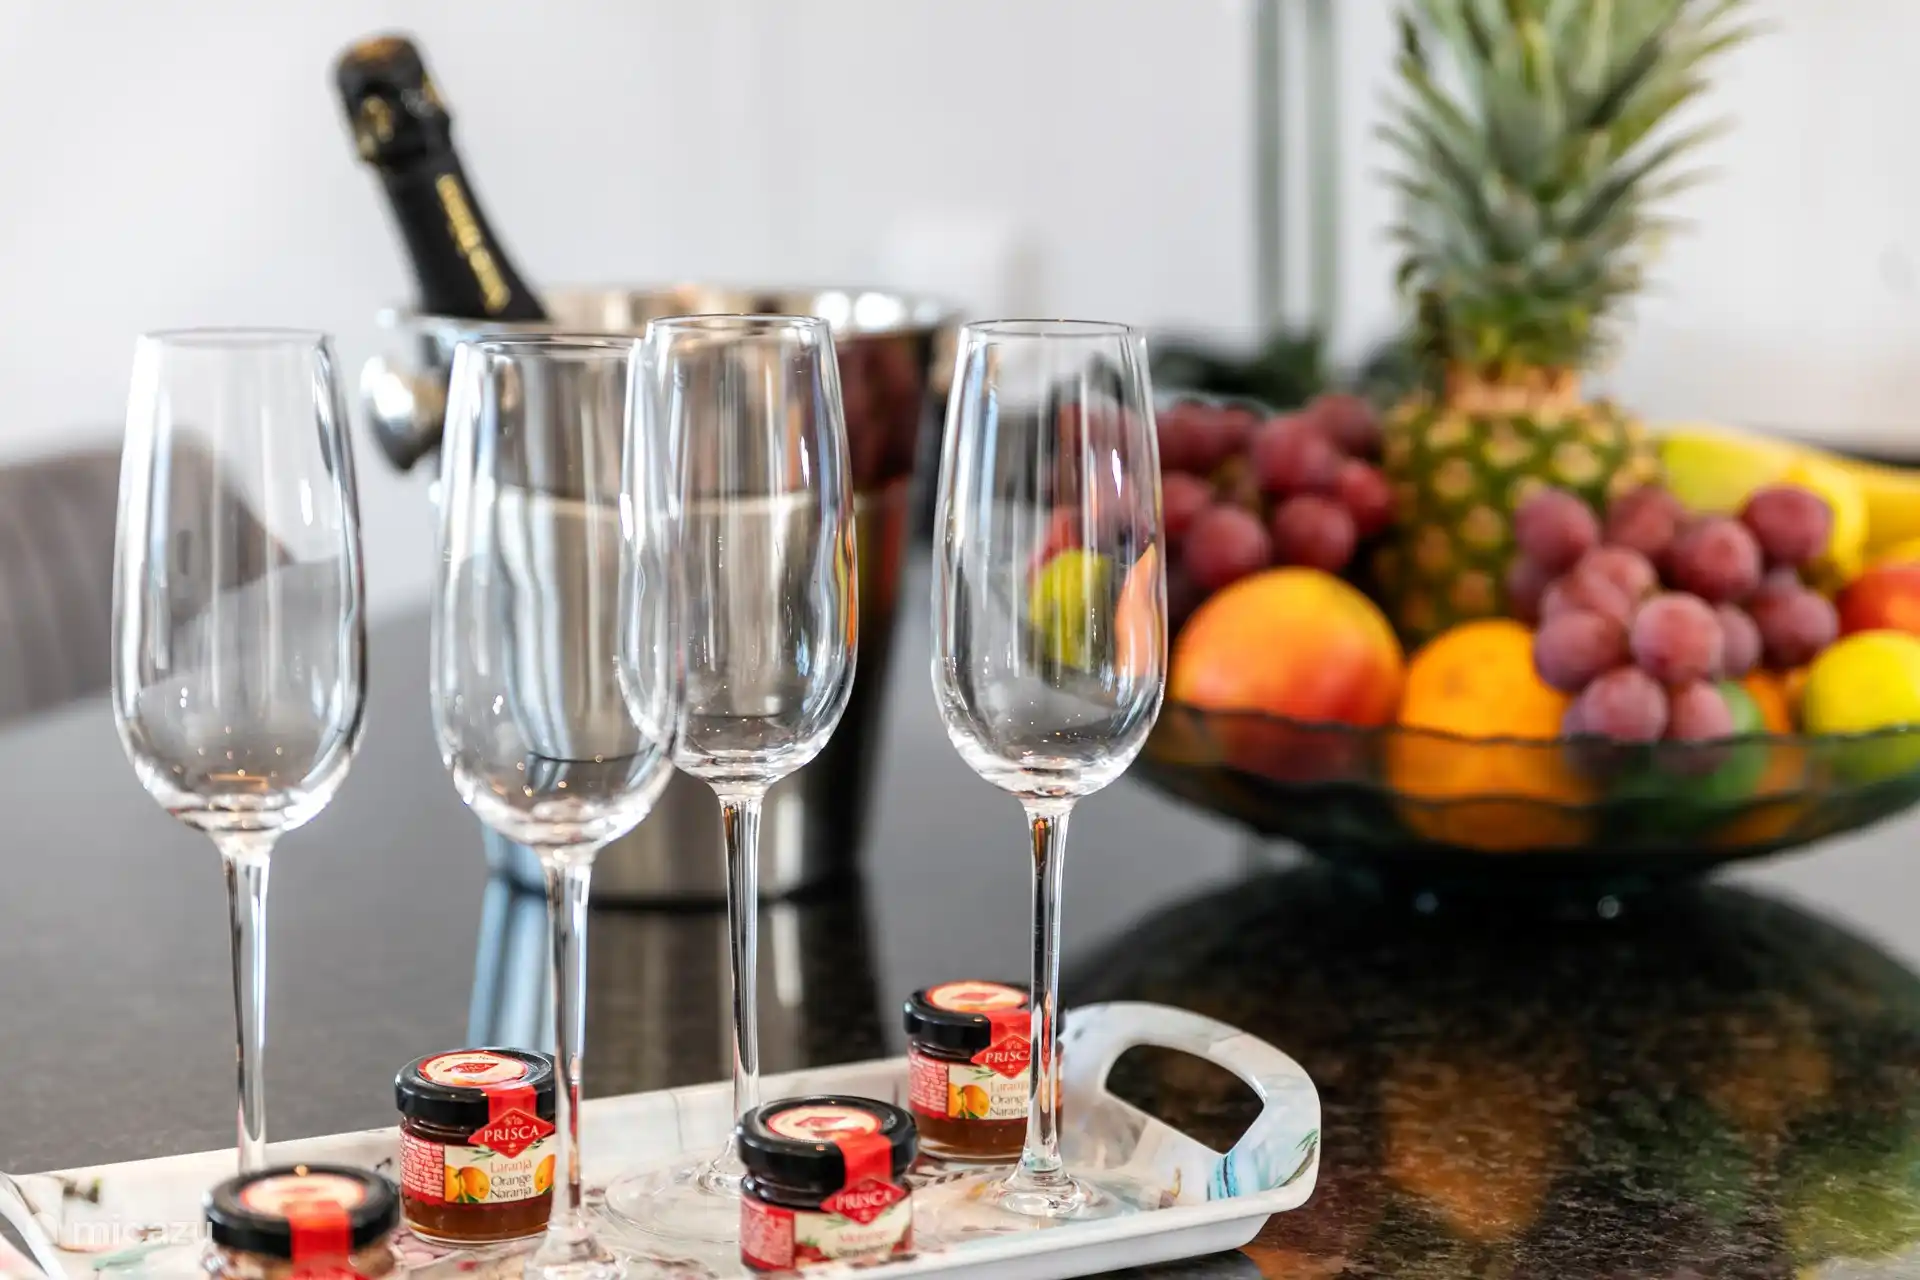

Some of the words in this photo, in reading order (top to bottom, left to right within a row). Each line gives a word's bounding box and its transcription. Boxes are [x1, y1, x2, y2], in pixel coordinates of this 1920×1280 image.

[985, 1049, 1031, 1063] PRISC
[484, 1125, 539, 1142] PRISCA
[490, 1160, 532, 1173] Laranja
[490, 1174, 532, 1187] Orange
[490, 1186, 532, 1199] Naranja
